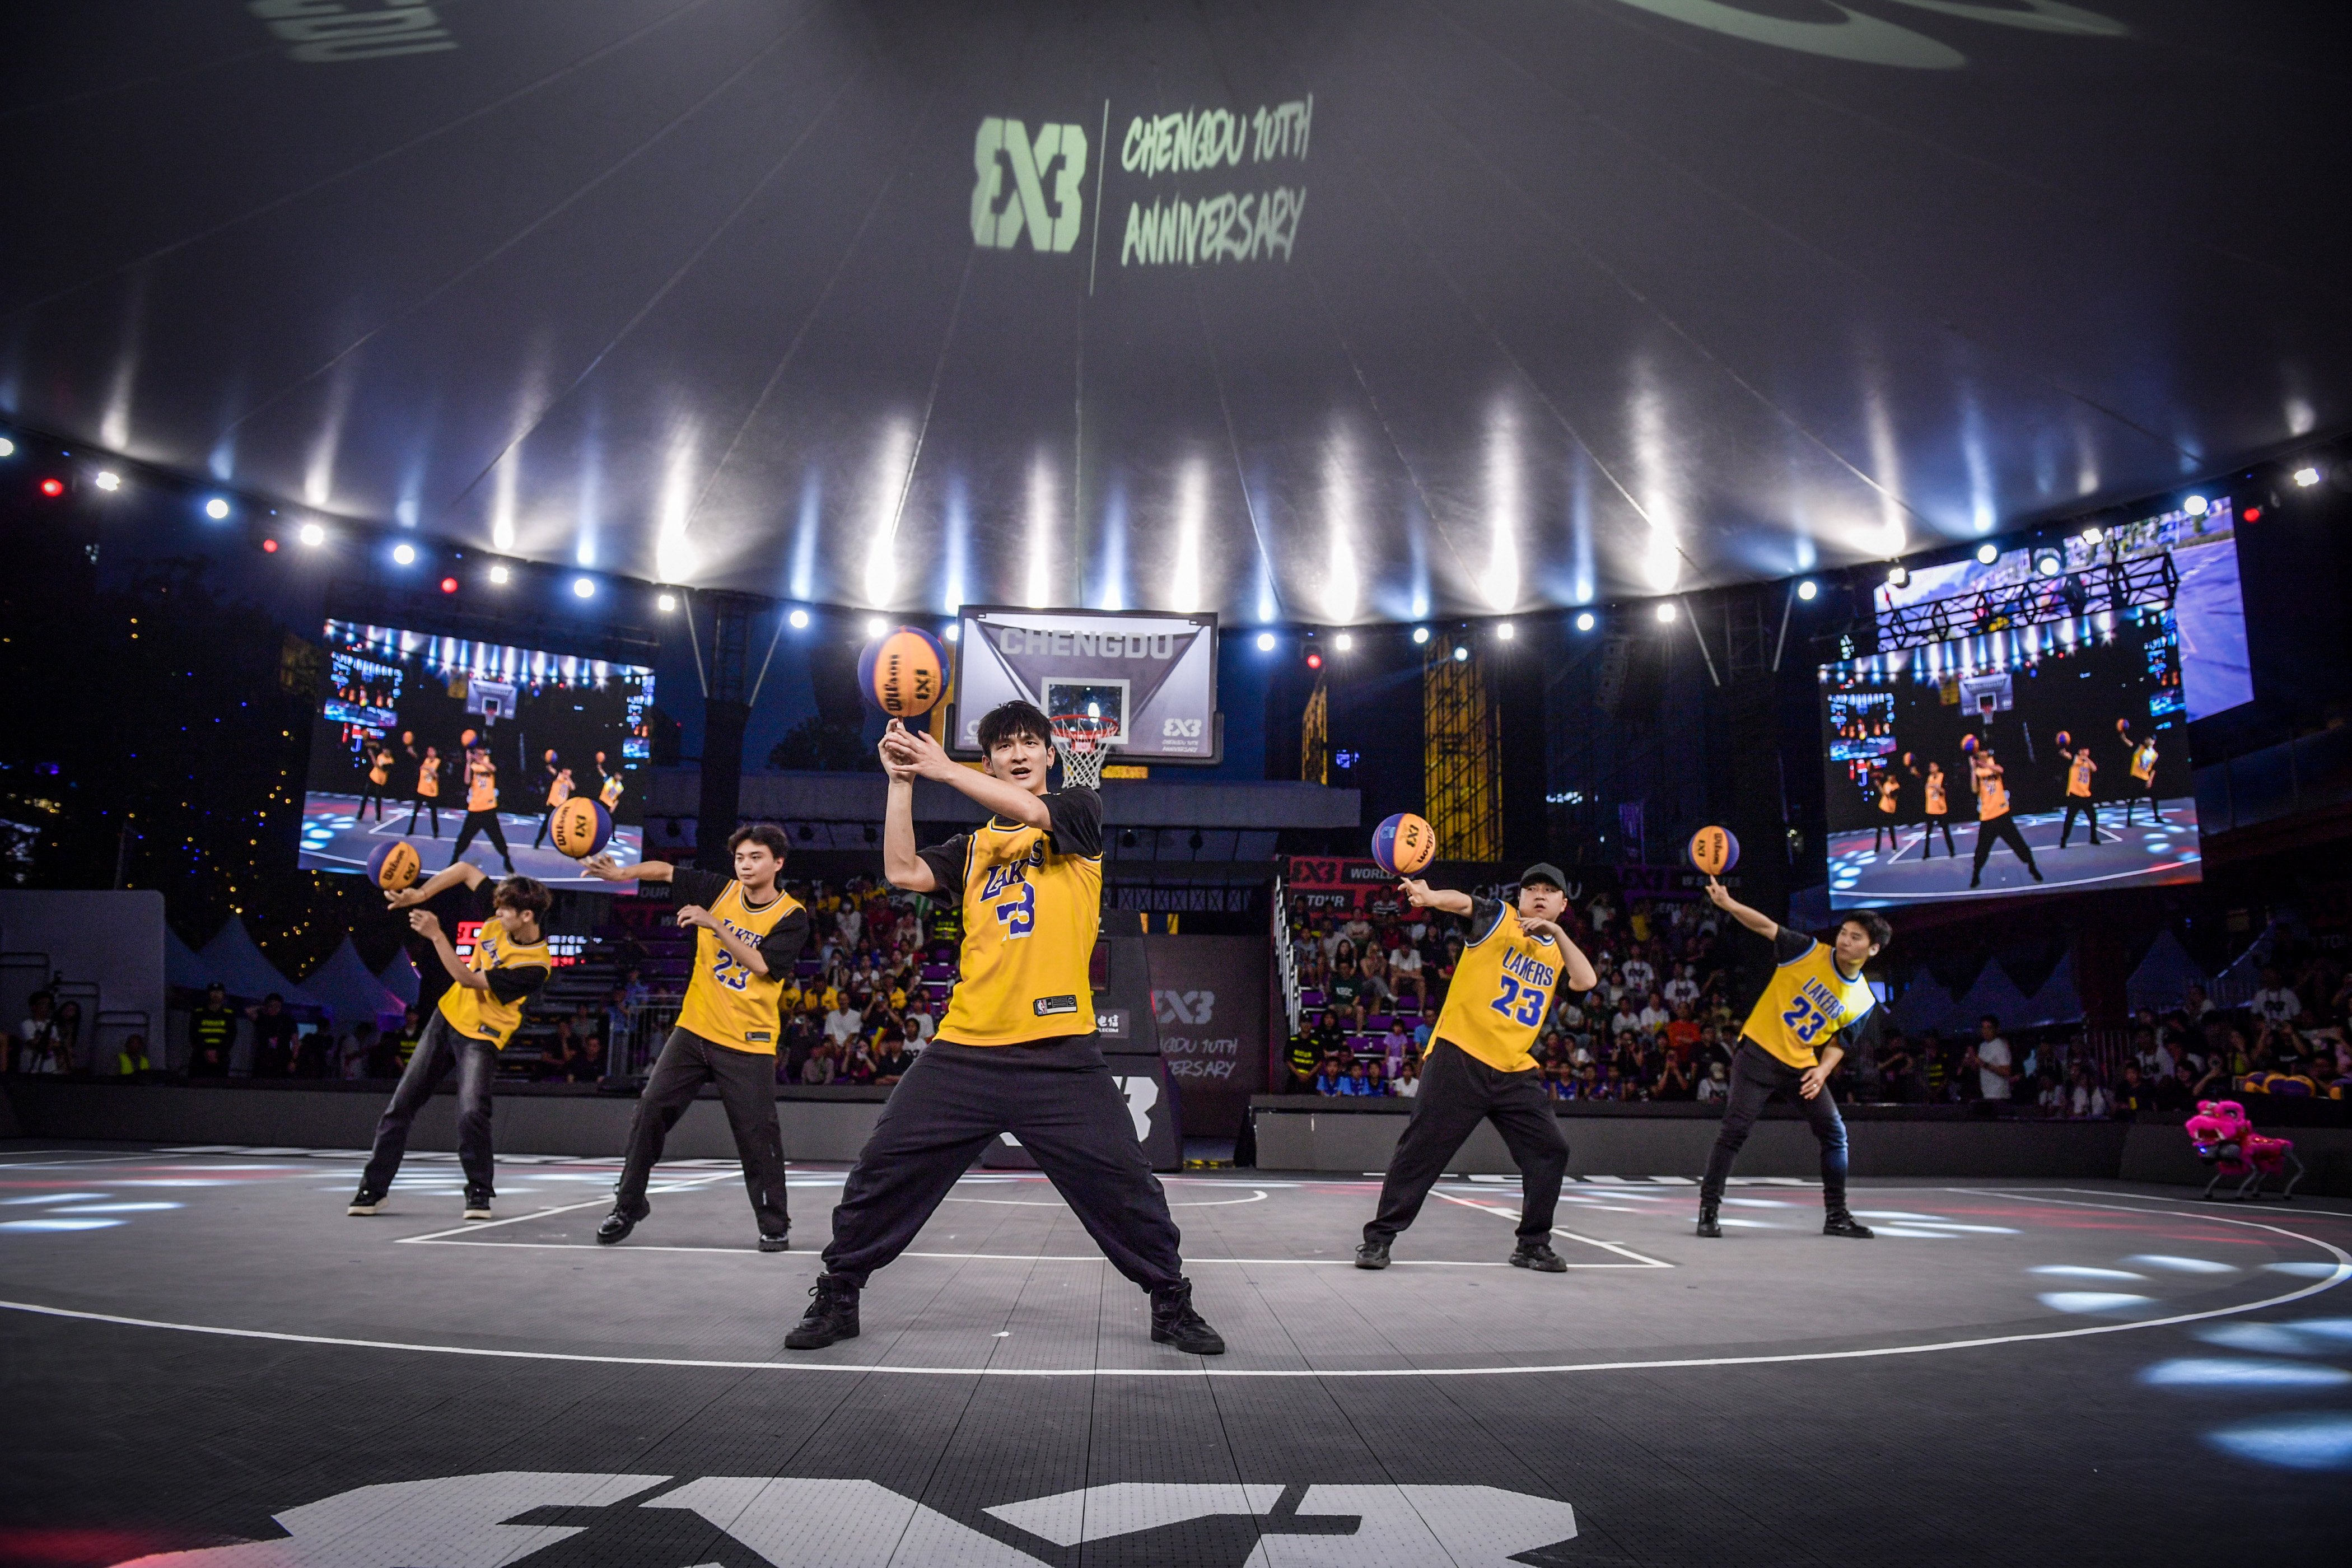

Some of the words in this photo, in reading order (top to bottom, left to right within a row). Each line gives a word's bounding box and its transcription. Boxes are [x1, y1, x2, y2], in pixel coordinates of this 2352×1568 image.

[1121, 104, 1247, 178] CHENGDU
[1252, 92, 1313, 163] 10TH
[1121, 185, 1306, 267] ANNIVERSARY
[1000, 627, 1174, 660] CHENGDU
[979, 839, 1045, 903] LAKS
[712, 917, 763, 949] AKER
[1502, 945, 1555, 988] LAKERS
[1488, 972, 1547, 1029] 23
[1781, 993, 1828, 1044] 23
[1802, 975, 1847, 1020] LAKERS
[1094, 1014, 1119, 1027] 电信
[1168, 1060, 1236, 1080] ERSARY
